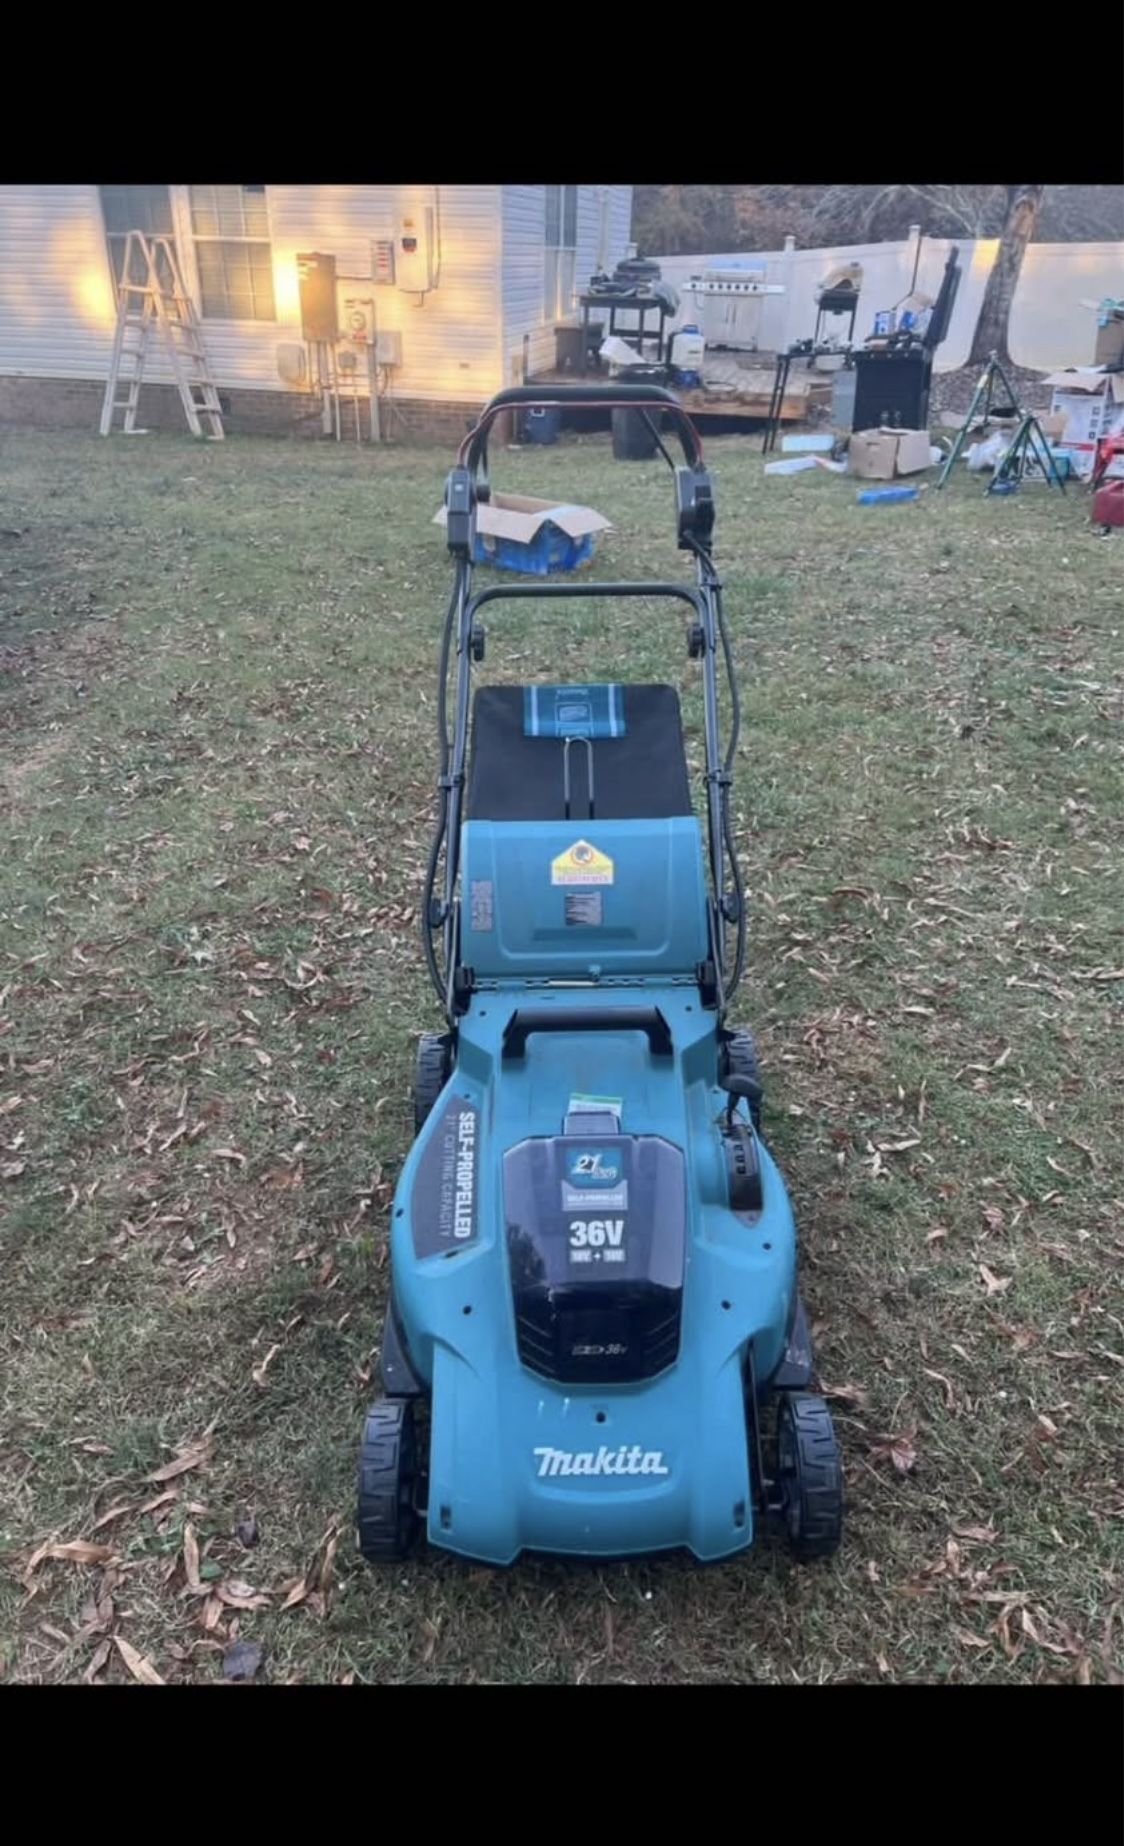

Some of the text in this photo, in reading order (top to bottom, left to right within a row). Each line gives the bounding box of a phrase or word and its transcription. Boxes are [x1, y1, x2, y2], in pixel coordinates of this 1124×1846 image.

[441, 1135, 455, 1180] CUTTING
[454, 1111, 475, 1238] SELF-PROPELLED
[572, 1152, 602, 1174] 21
[439, 1184, 454, 1237] CAPACITY
[570, 1220, 624, 1247] 36V
